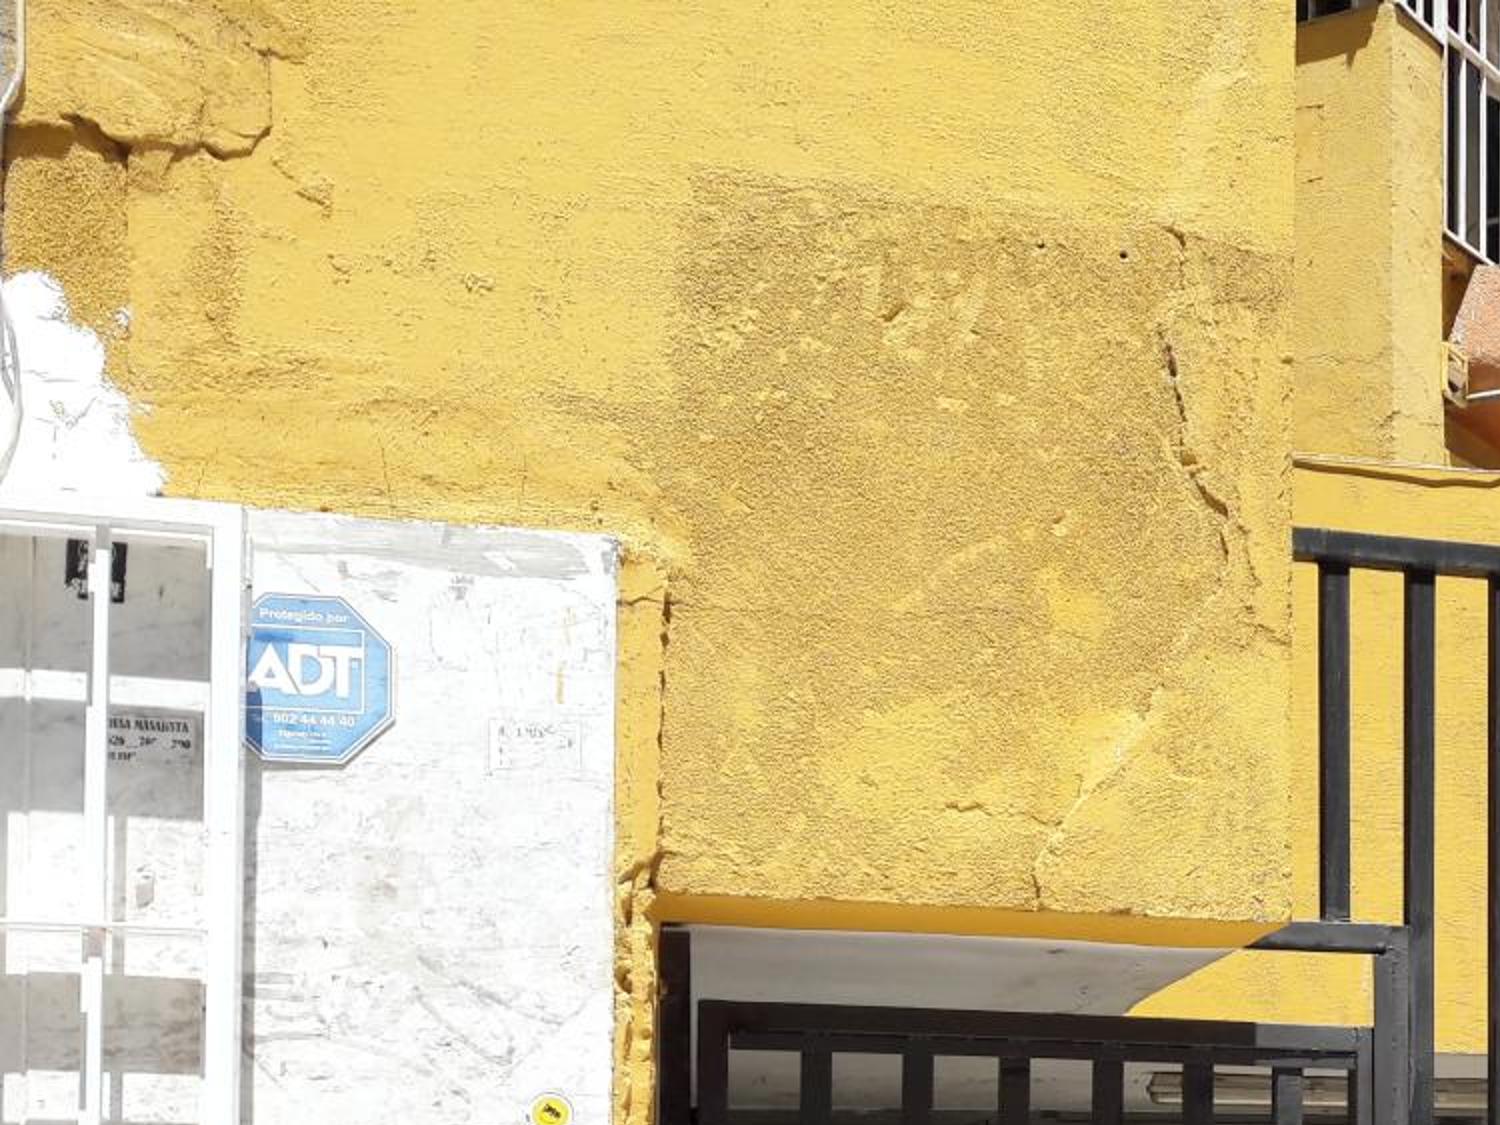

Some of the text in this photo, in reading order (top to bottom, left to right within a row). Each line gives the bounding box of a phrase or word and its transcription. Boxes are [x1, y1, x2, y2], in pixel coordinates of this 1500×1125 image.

[259, 607, 349, 624] Protegido por
[248, 643, 363, 700] ADT
